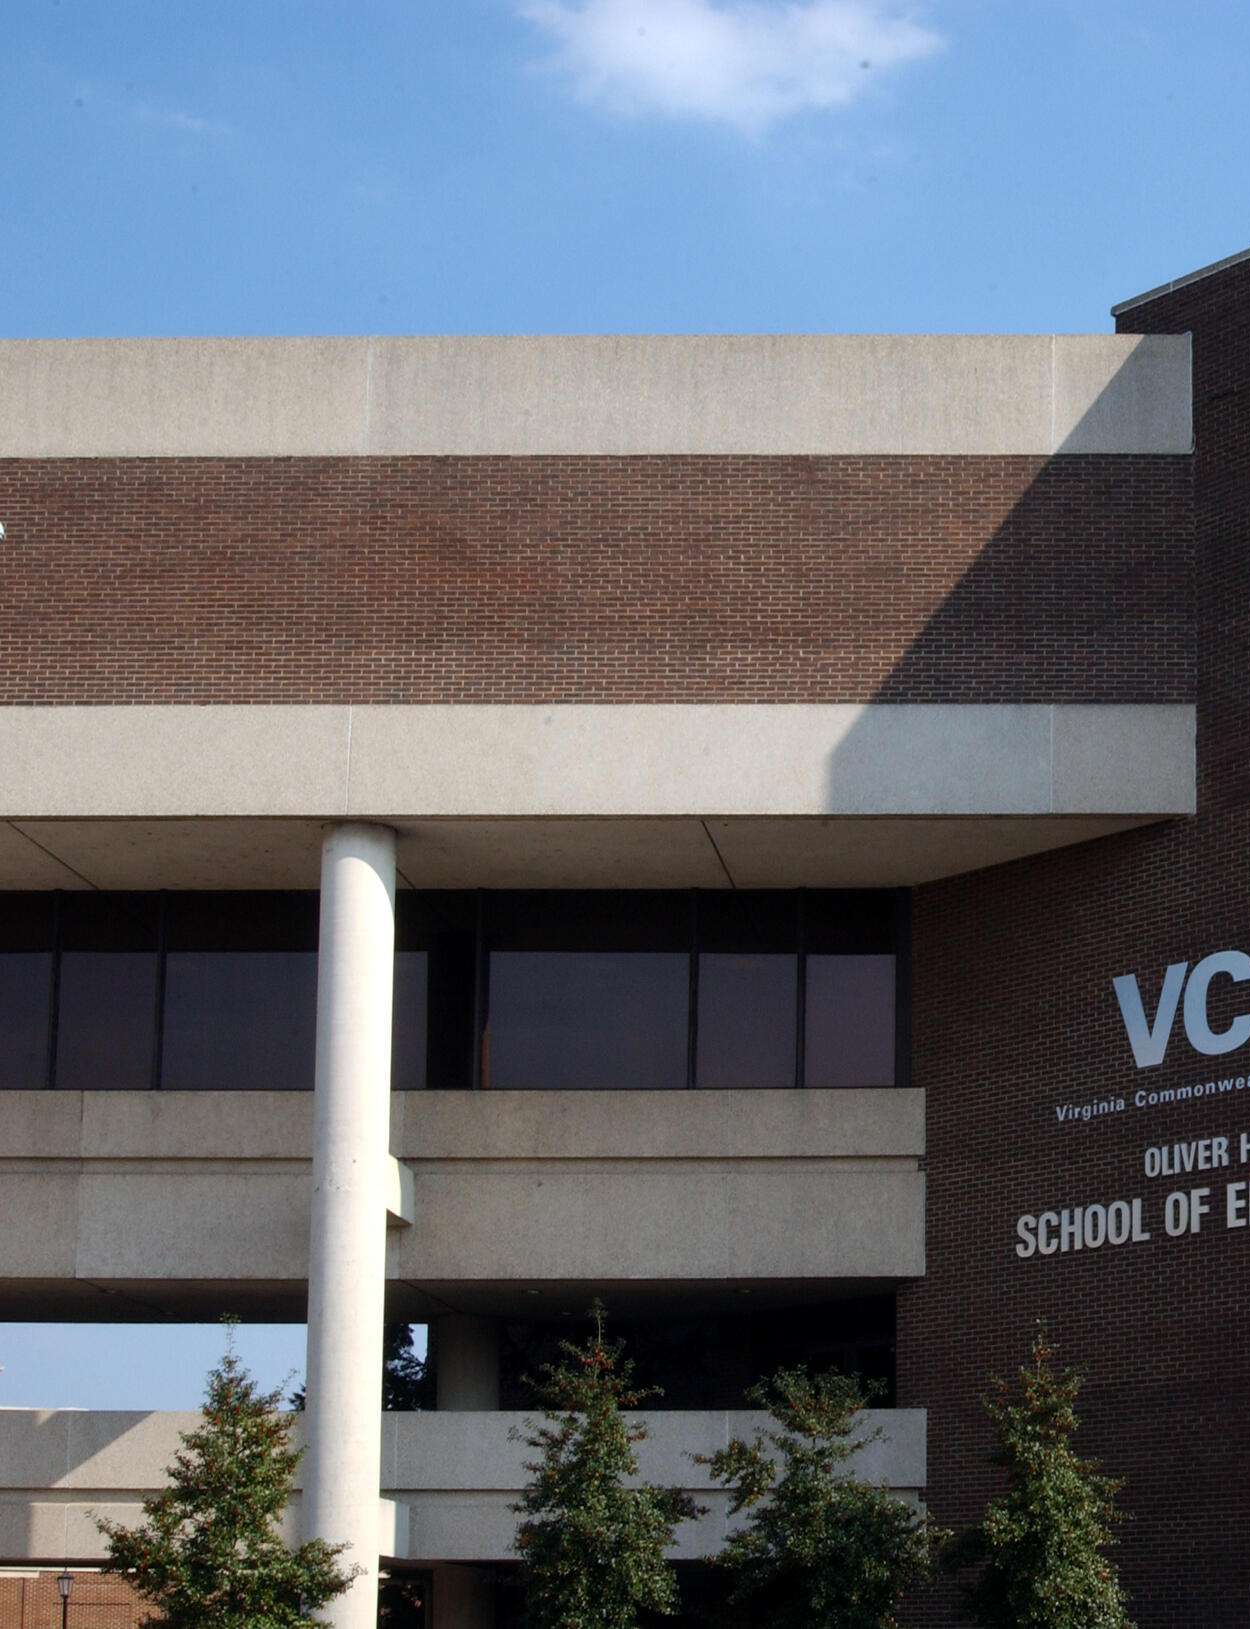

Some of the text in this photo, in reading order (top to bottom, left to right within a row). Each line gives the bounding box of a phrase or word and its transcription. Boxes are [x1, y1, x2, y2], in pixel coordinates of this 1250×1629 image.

[1056, 1096, 1126, 1122] Virginia
[1144, 1136, 1230, 1179] OLIVER
[1015, 1198, 1151, 1259] SCHOOL
[1164, 1187, 1210, 1237] OF
